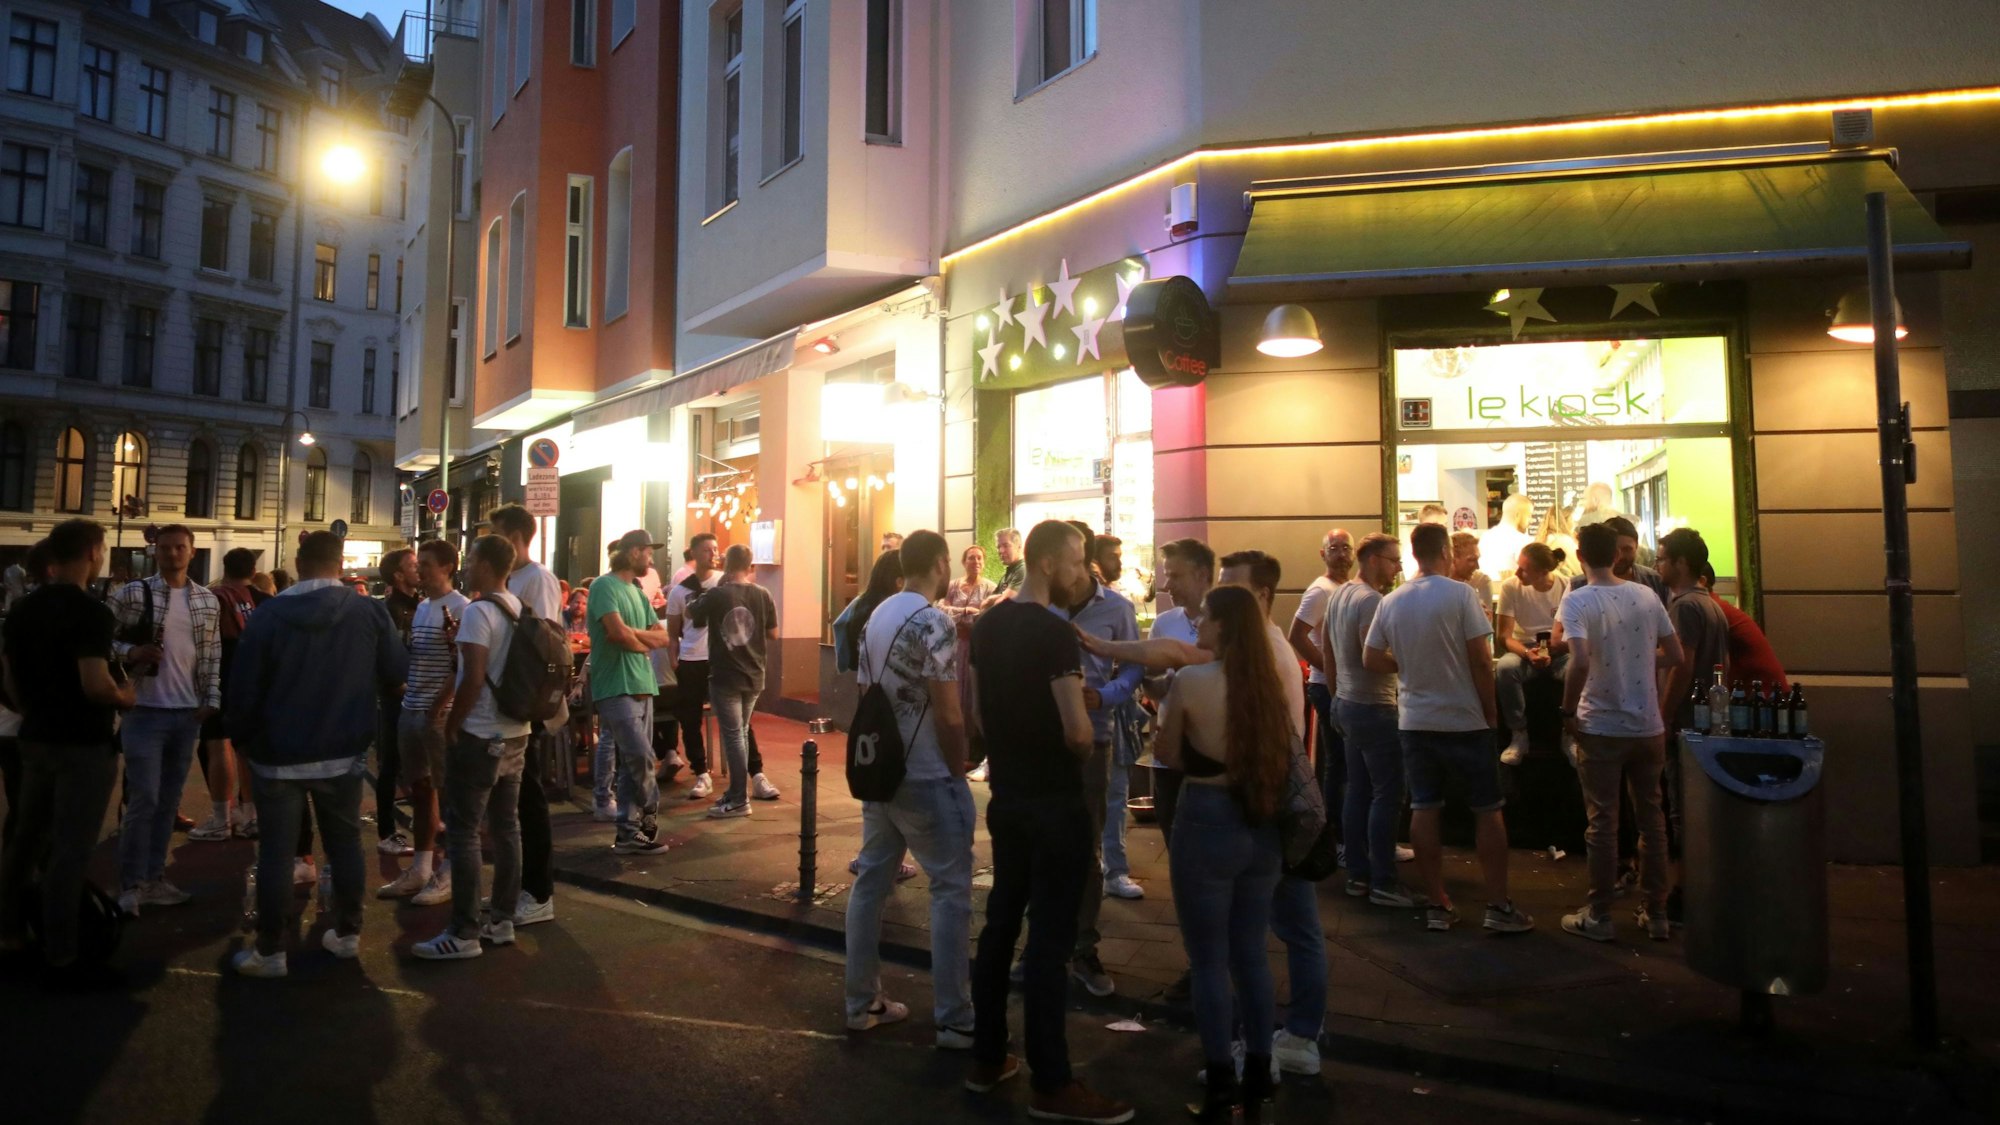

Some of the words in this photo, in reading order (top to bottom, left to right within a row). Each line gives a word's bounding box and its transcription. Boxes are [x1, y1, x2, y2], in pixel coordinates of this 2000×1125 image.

[1164, 350, 1207, 376] Coffee
[1467, 386, 1507, 420] le
[1519, 381, 1650, 420] kiosk
[528, 473, 556, 481] Ladezone
